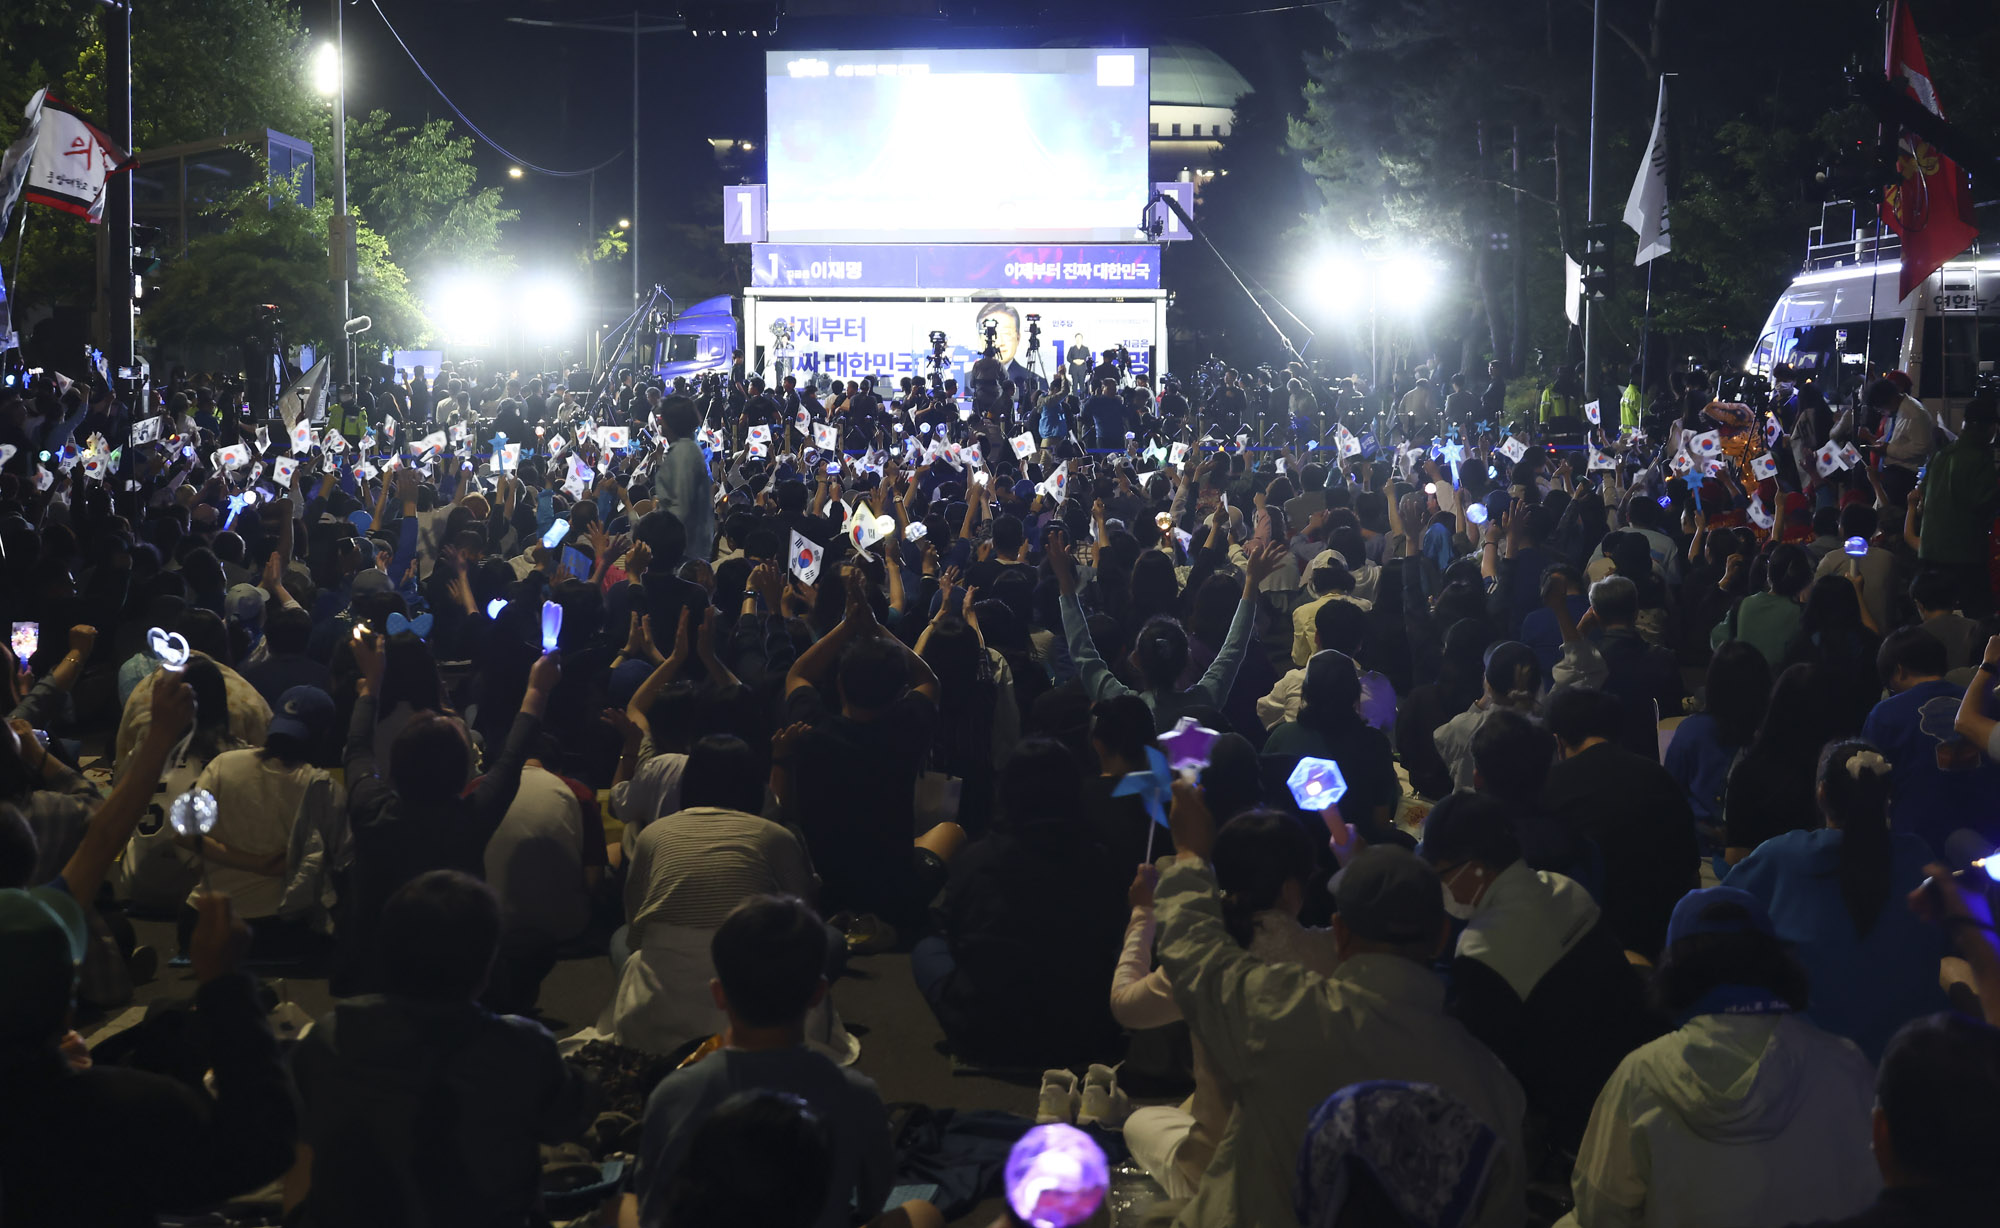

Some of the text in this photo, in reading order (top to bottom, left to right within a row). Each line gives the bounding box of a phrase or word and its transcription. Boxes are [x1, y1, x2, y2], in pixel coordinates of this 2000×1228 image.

[737, 192, 752, 235] 1
[1164, 189, 1179, 232] 1
[768, 253, 779, 279] 1
[811, 261, 863, 280] 이재명
[1004, 262, 1150, 281] 이제부터 진짜 대한민국
[1123, 339, 1149, 348] 지금은
[825, 351, 919, 377] 대한민국
